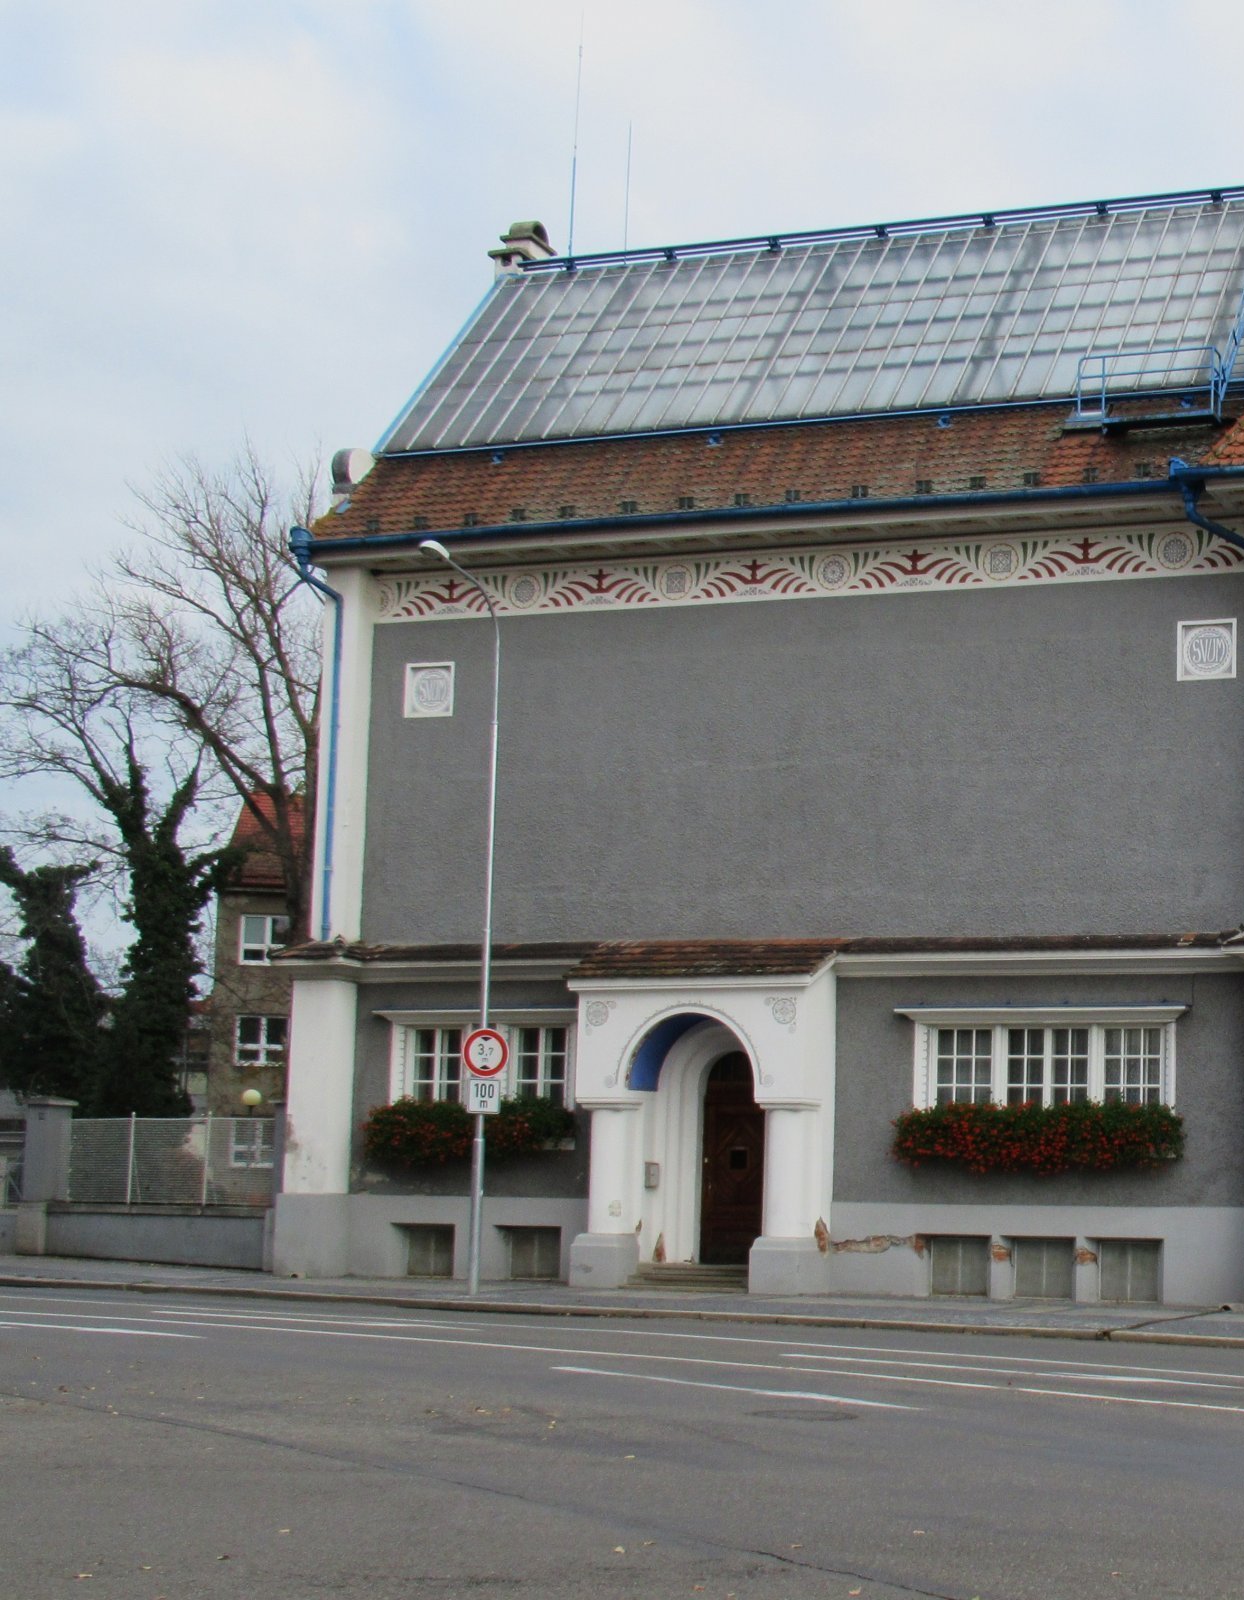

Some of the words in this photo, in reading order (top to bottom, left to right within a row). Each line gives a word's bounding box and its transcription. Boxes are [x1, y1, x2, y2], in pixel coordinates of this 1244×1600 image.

[1192, 638, 1226, 663] SVUM
[474, 1083, 495, 1099] 100
[479, 1100, 488, 1109] m
